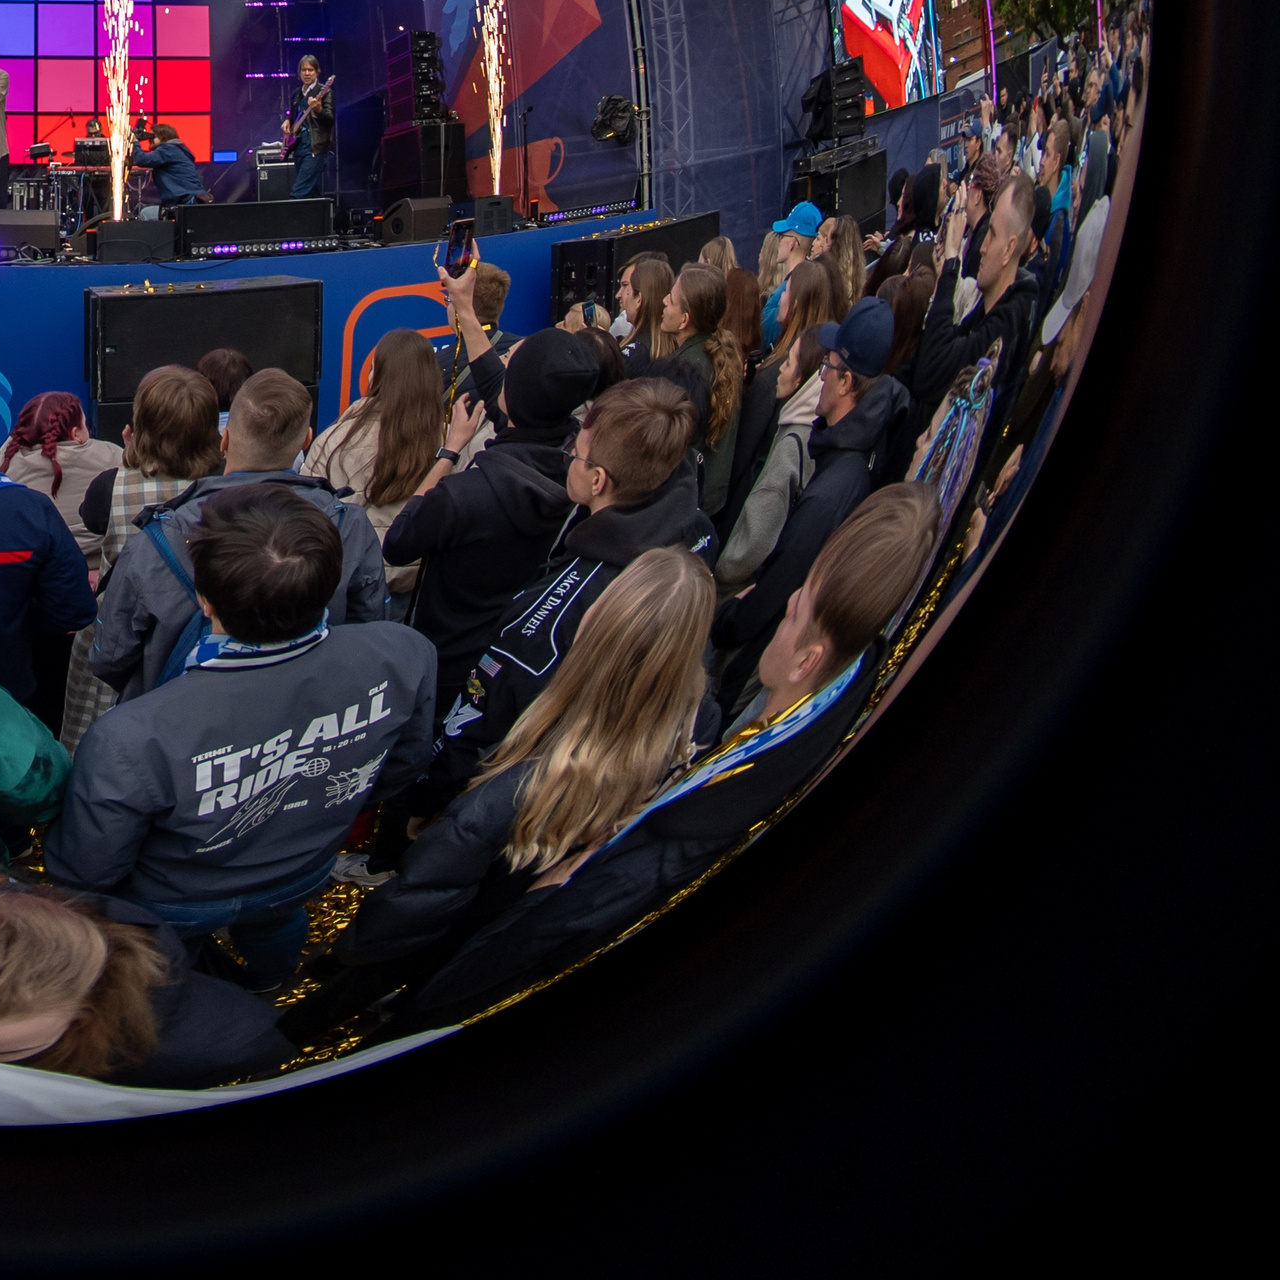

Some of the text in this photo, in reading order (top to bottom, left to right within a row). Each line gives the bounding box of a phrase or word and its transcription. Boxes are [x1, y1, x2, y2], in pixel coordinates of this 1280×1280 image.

[553, 570, 580, 597] JACK
[191, 744, 234, 764] TERMIT
[195, 729, 293, 792] IT'S
[298, 692, 391, 747] ALL
[197, 747, 314, 817] RIDE
[283, 799, 308, 811] 1989
